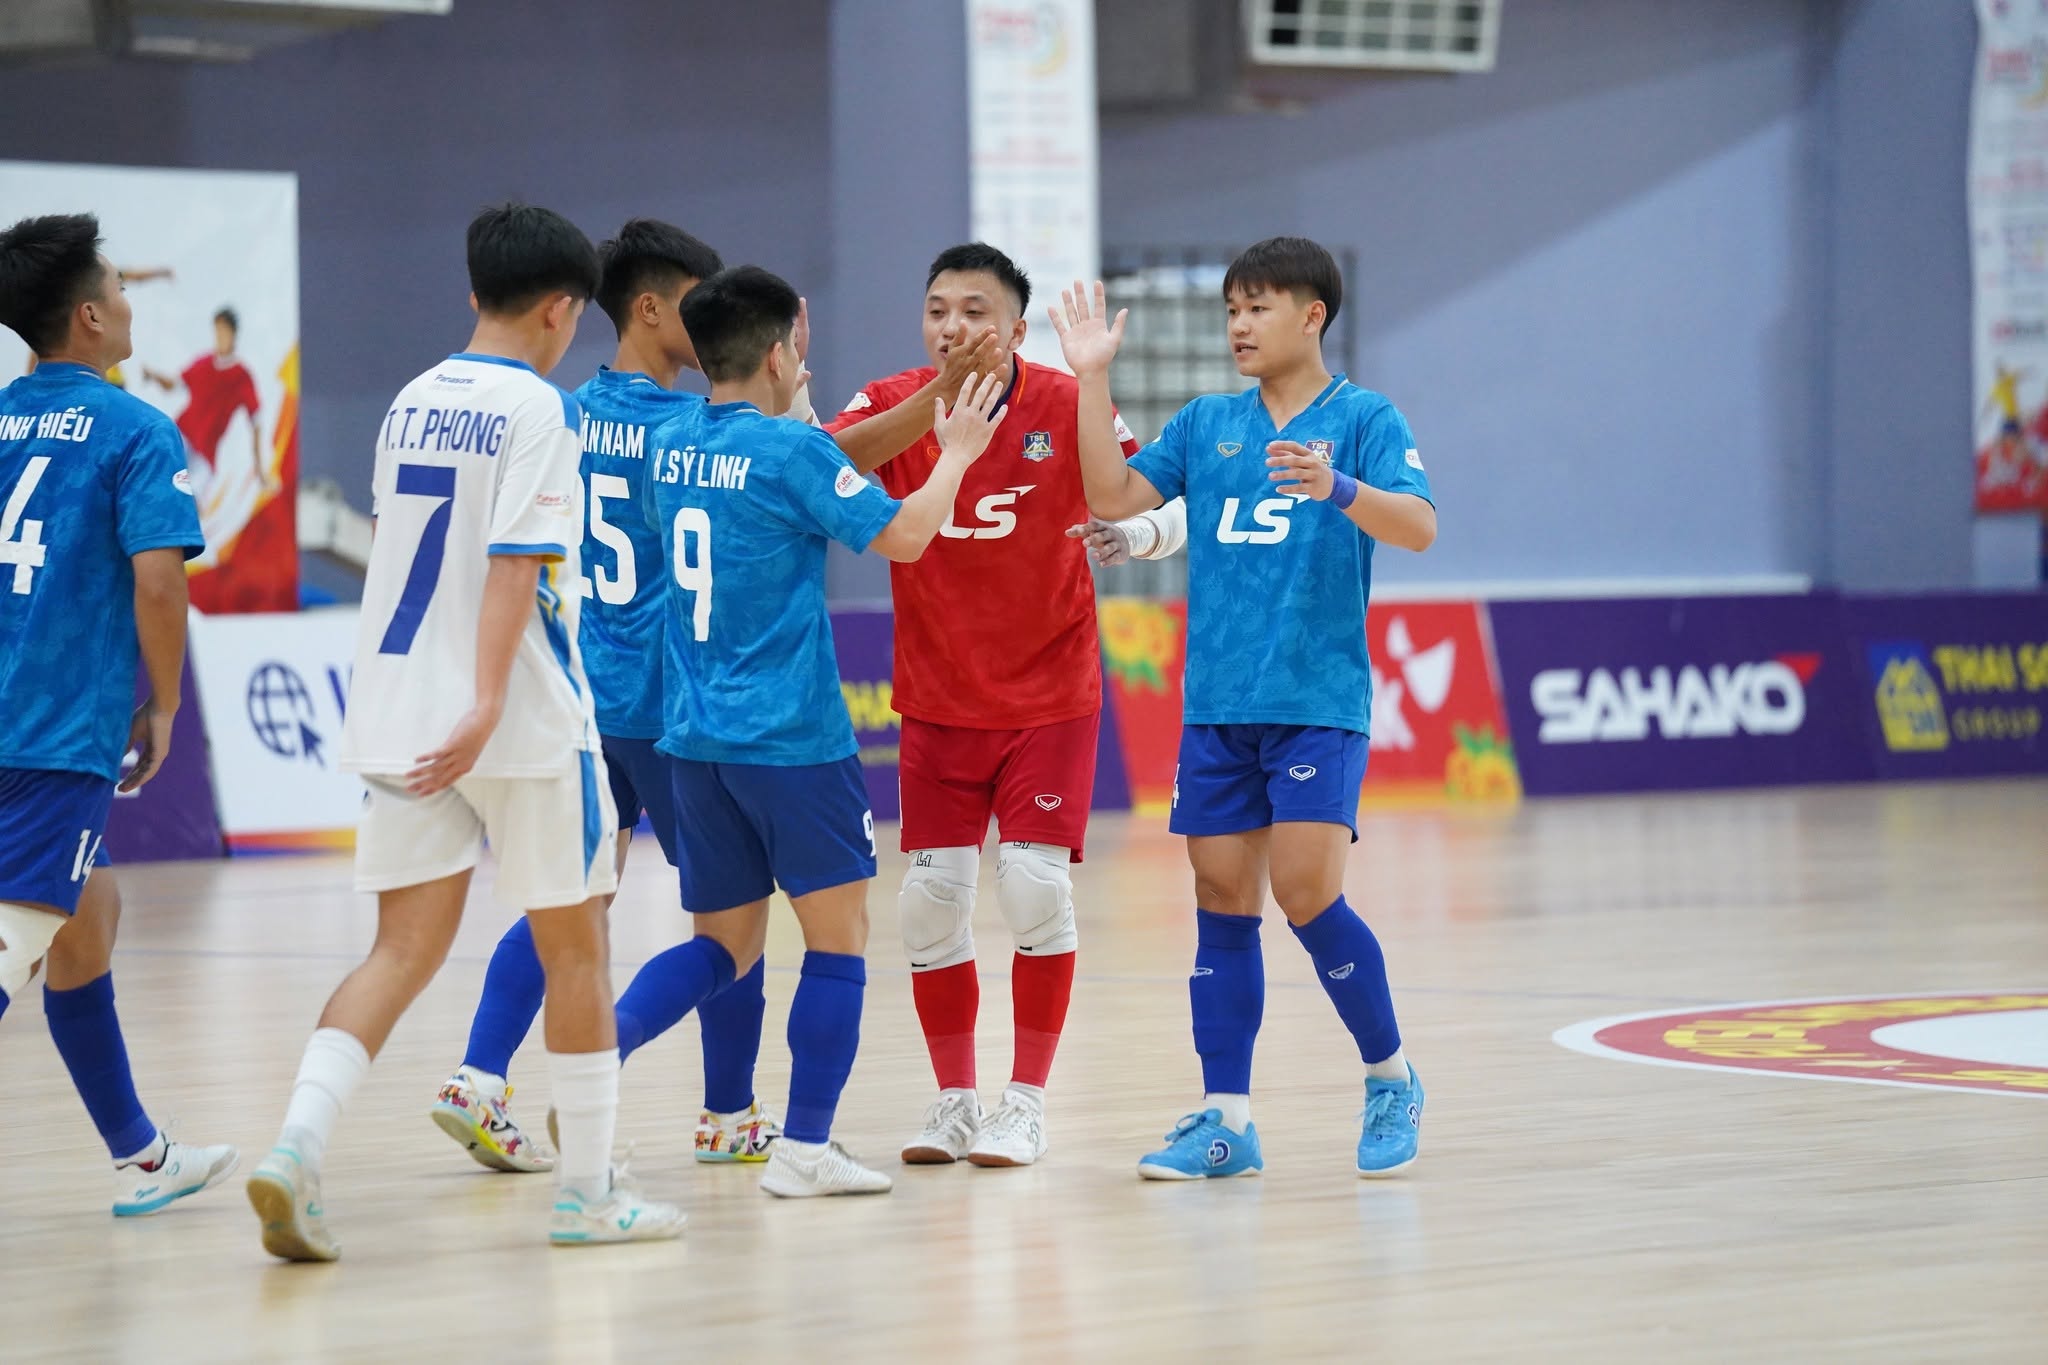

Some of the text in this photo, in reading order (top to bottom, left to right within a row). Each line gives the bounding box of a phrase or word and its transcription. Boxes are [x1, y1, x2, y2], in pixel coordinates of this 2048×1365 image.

[36, 405, 94, 442] HIẾU
[1311, 442, 1329, 450] TSB
[697, 453, 752, 490] LINH
[1216, 497, 1295, 545] LS
[378, 463, 457, 656] 7
[673, 506, 714, 642] 9
[1529, 660, 1806, 744] SAHAKO
